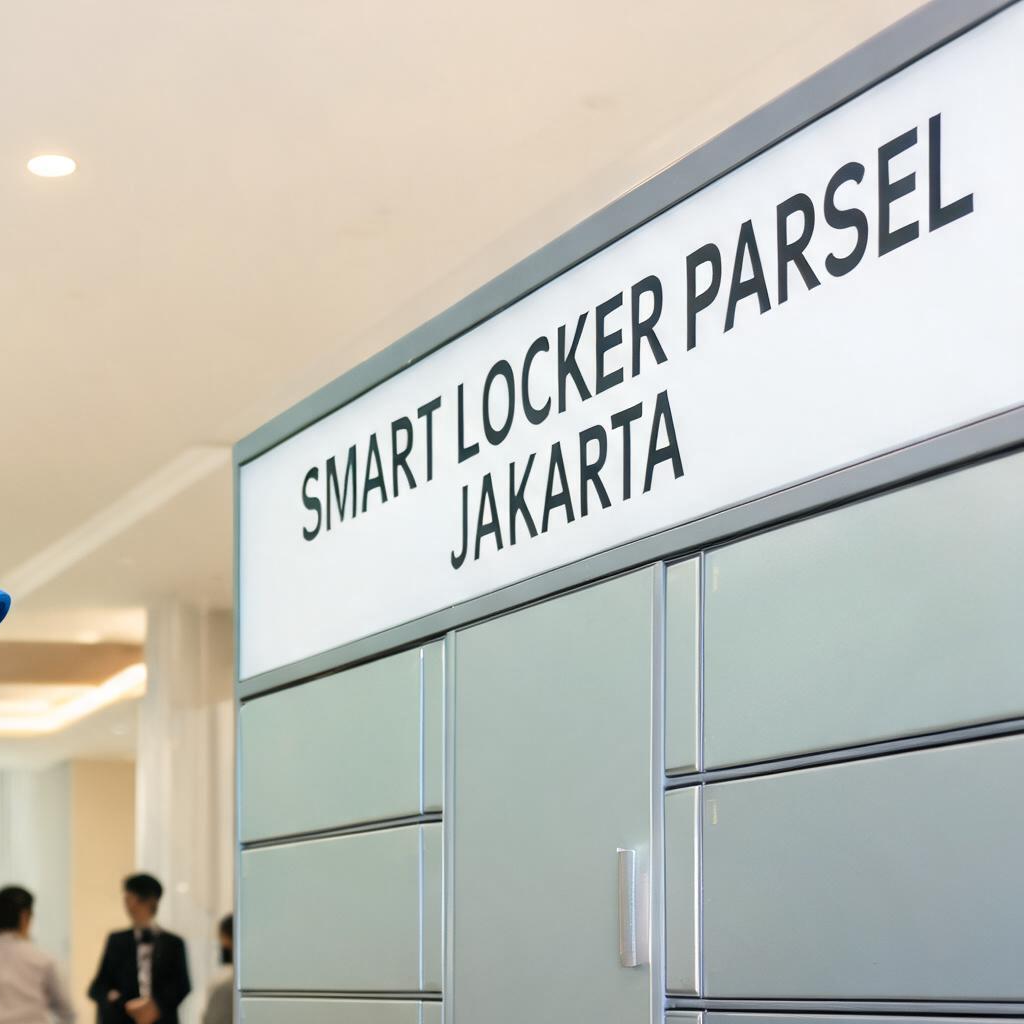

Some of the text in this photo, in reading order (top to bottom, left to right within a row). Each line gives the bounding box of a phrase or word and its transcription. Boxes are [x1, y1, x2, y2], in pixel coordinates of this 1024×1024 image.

[301, 112, 975, 542] SMART LOCKER PARSEL
[450, 389, 685, 570] JAKARTA
